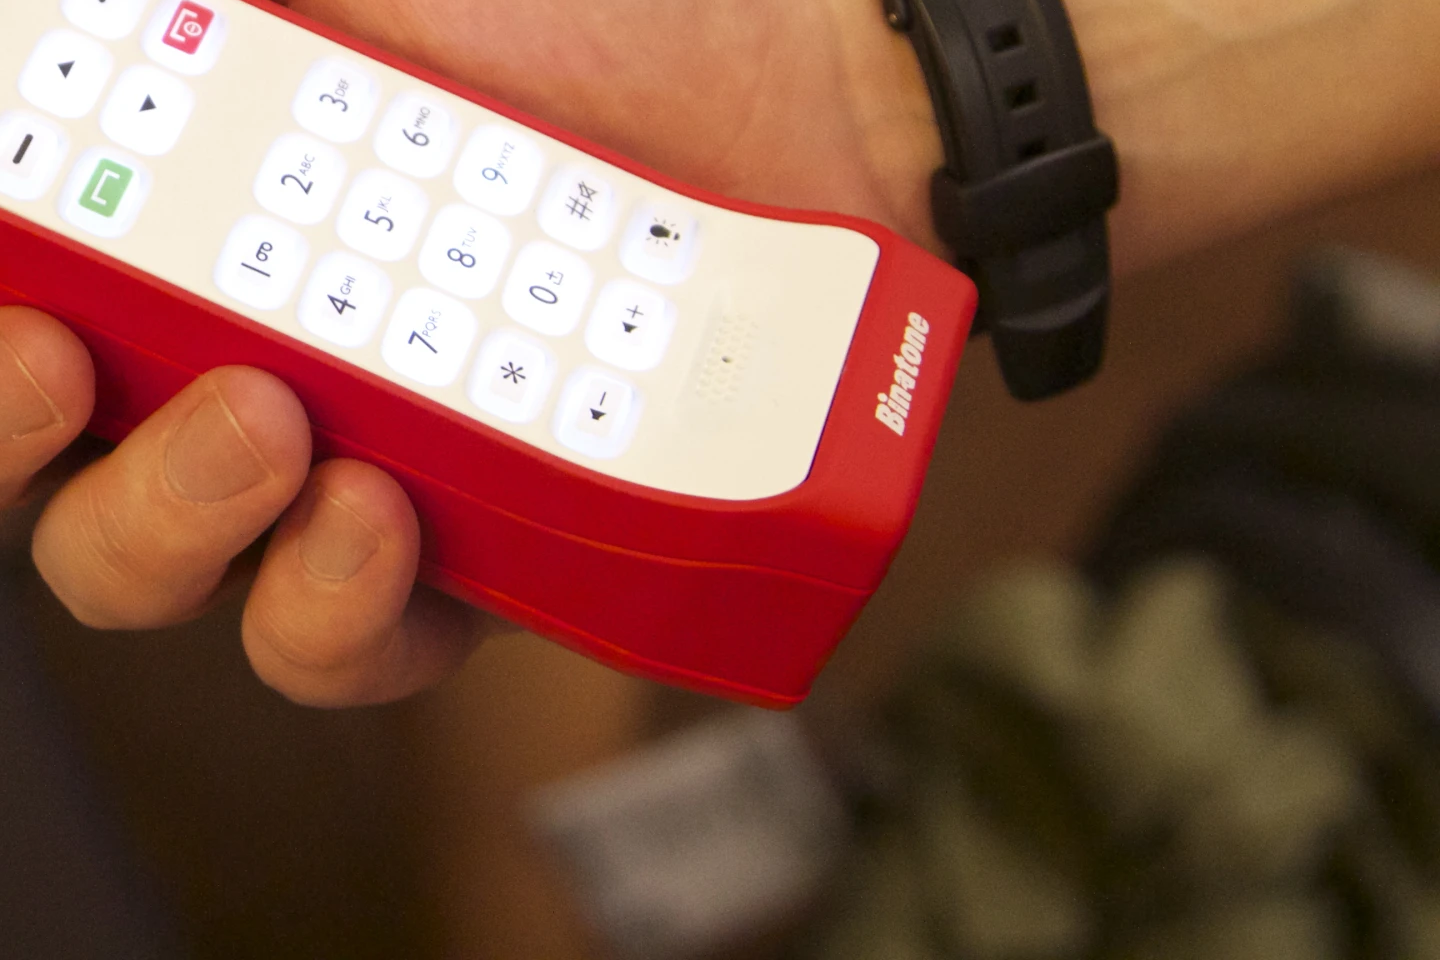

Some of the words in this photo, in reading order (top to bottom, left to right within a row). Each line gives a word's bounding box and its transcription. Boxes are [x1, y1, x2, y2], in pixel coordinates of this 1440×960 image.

[319, 93, 348, 112] 3
[334, 78, 349, 97] DEF
[413, 106, 430, 130] MNO
[402, 128, 430, 147] 6
[280, 173, 314, 195] 2
[298, 153, 315, 176] ABC
[481, 167, 508, 184] 9
[377, 195, 392, 213] JKL
[364, 210, 394, 232] 5
[461, 227, 477, 248] TUV
[447, 247, 476, 268] 8
[339, 275, 356, 295] GHI
[528, 285, 558, 305] 0
[327, 294, 356, 315] 4
[422, 309, 442, 338] PQRS
[408, 330, 438, 354] 7
[874, 311, 930, 437] Binatone
